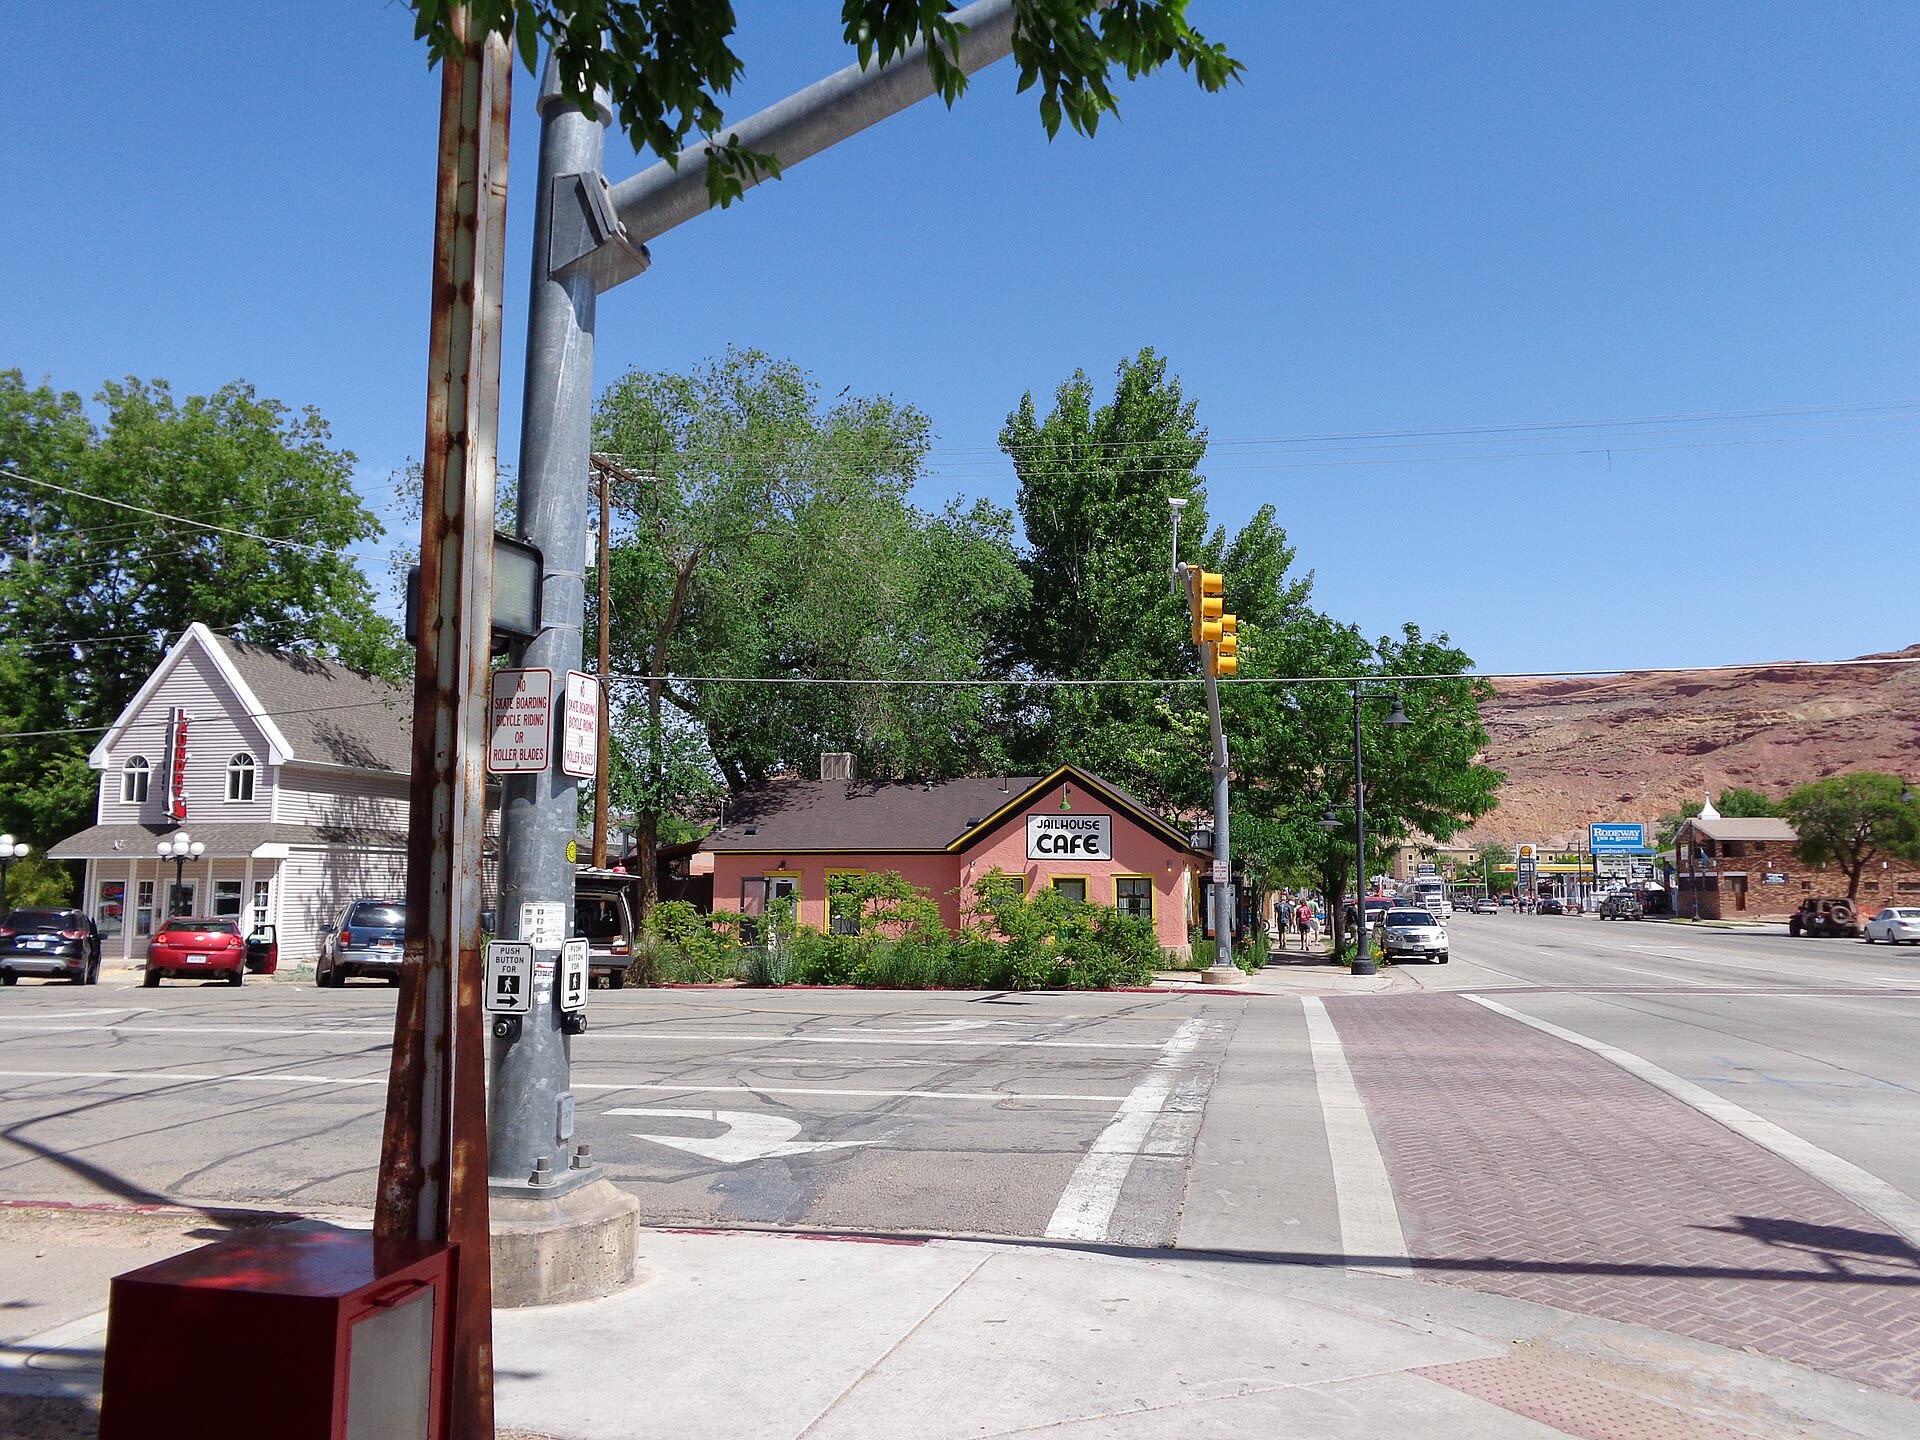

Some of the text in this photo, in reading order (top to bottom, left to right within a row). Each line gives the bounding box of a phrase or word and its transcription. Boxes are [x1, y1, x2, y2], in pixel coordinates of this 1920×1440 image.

[517, 680, 526, 692] NO
[580, 685, 585, 697] NO
[495, 697, 546, 709] SKATE BOARDING
[496, 714, 543, 726] BICYCLE RIDING
[515, 732, 524, 744] OR
[578, 736, 584, 747] OR
[173, 709, 187, 797] LAUNDRY
[493, 749, 543, 761] ROLLER BLADES
[1037, 819, 1100, 830] JAILHOUSE
[1594, 828, 1640, 836] RODEWAY
[1036, 834, 1099, 854] CAFE
[500, 947, 520, 955] PUSH
[570, 945, 581, 953] PUSH
[495, 956, 524, 964] BUTTON
[567, 954, 583, 962] BUTTON
[502, 965, 517, 973] FOR
[571, 961, 579, 970] FOR
